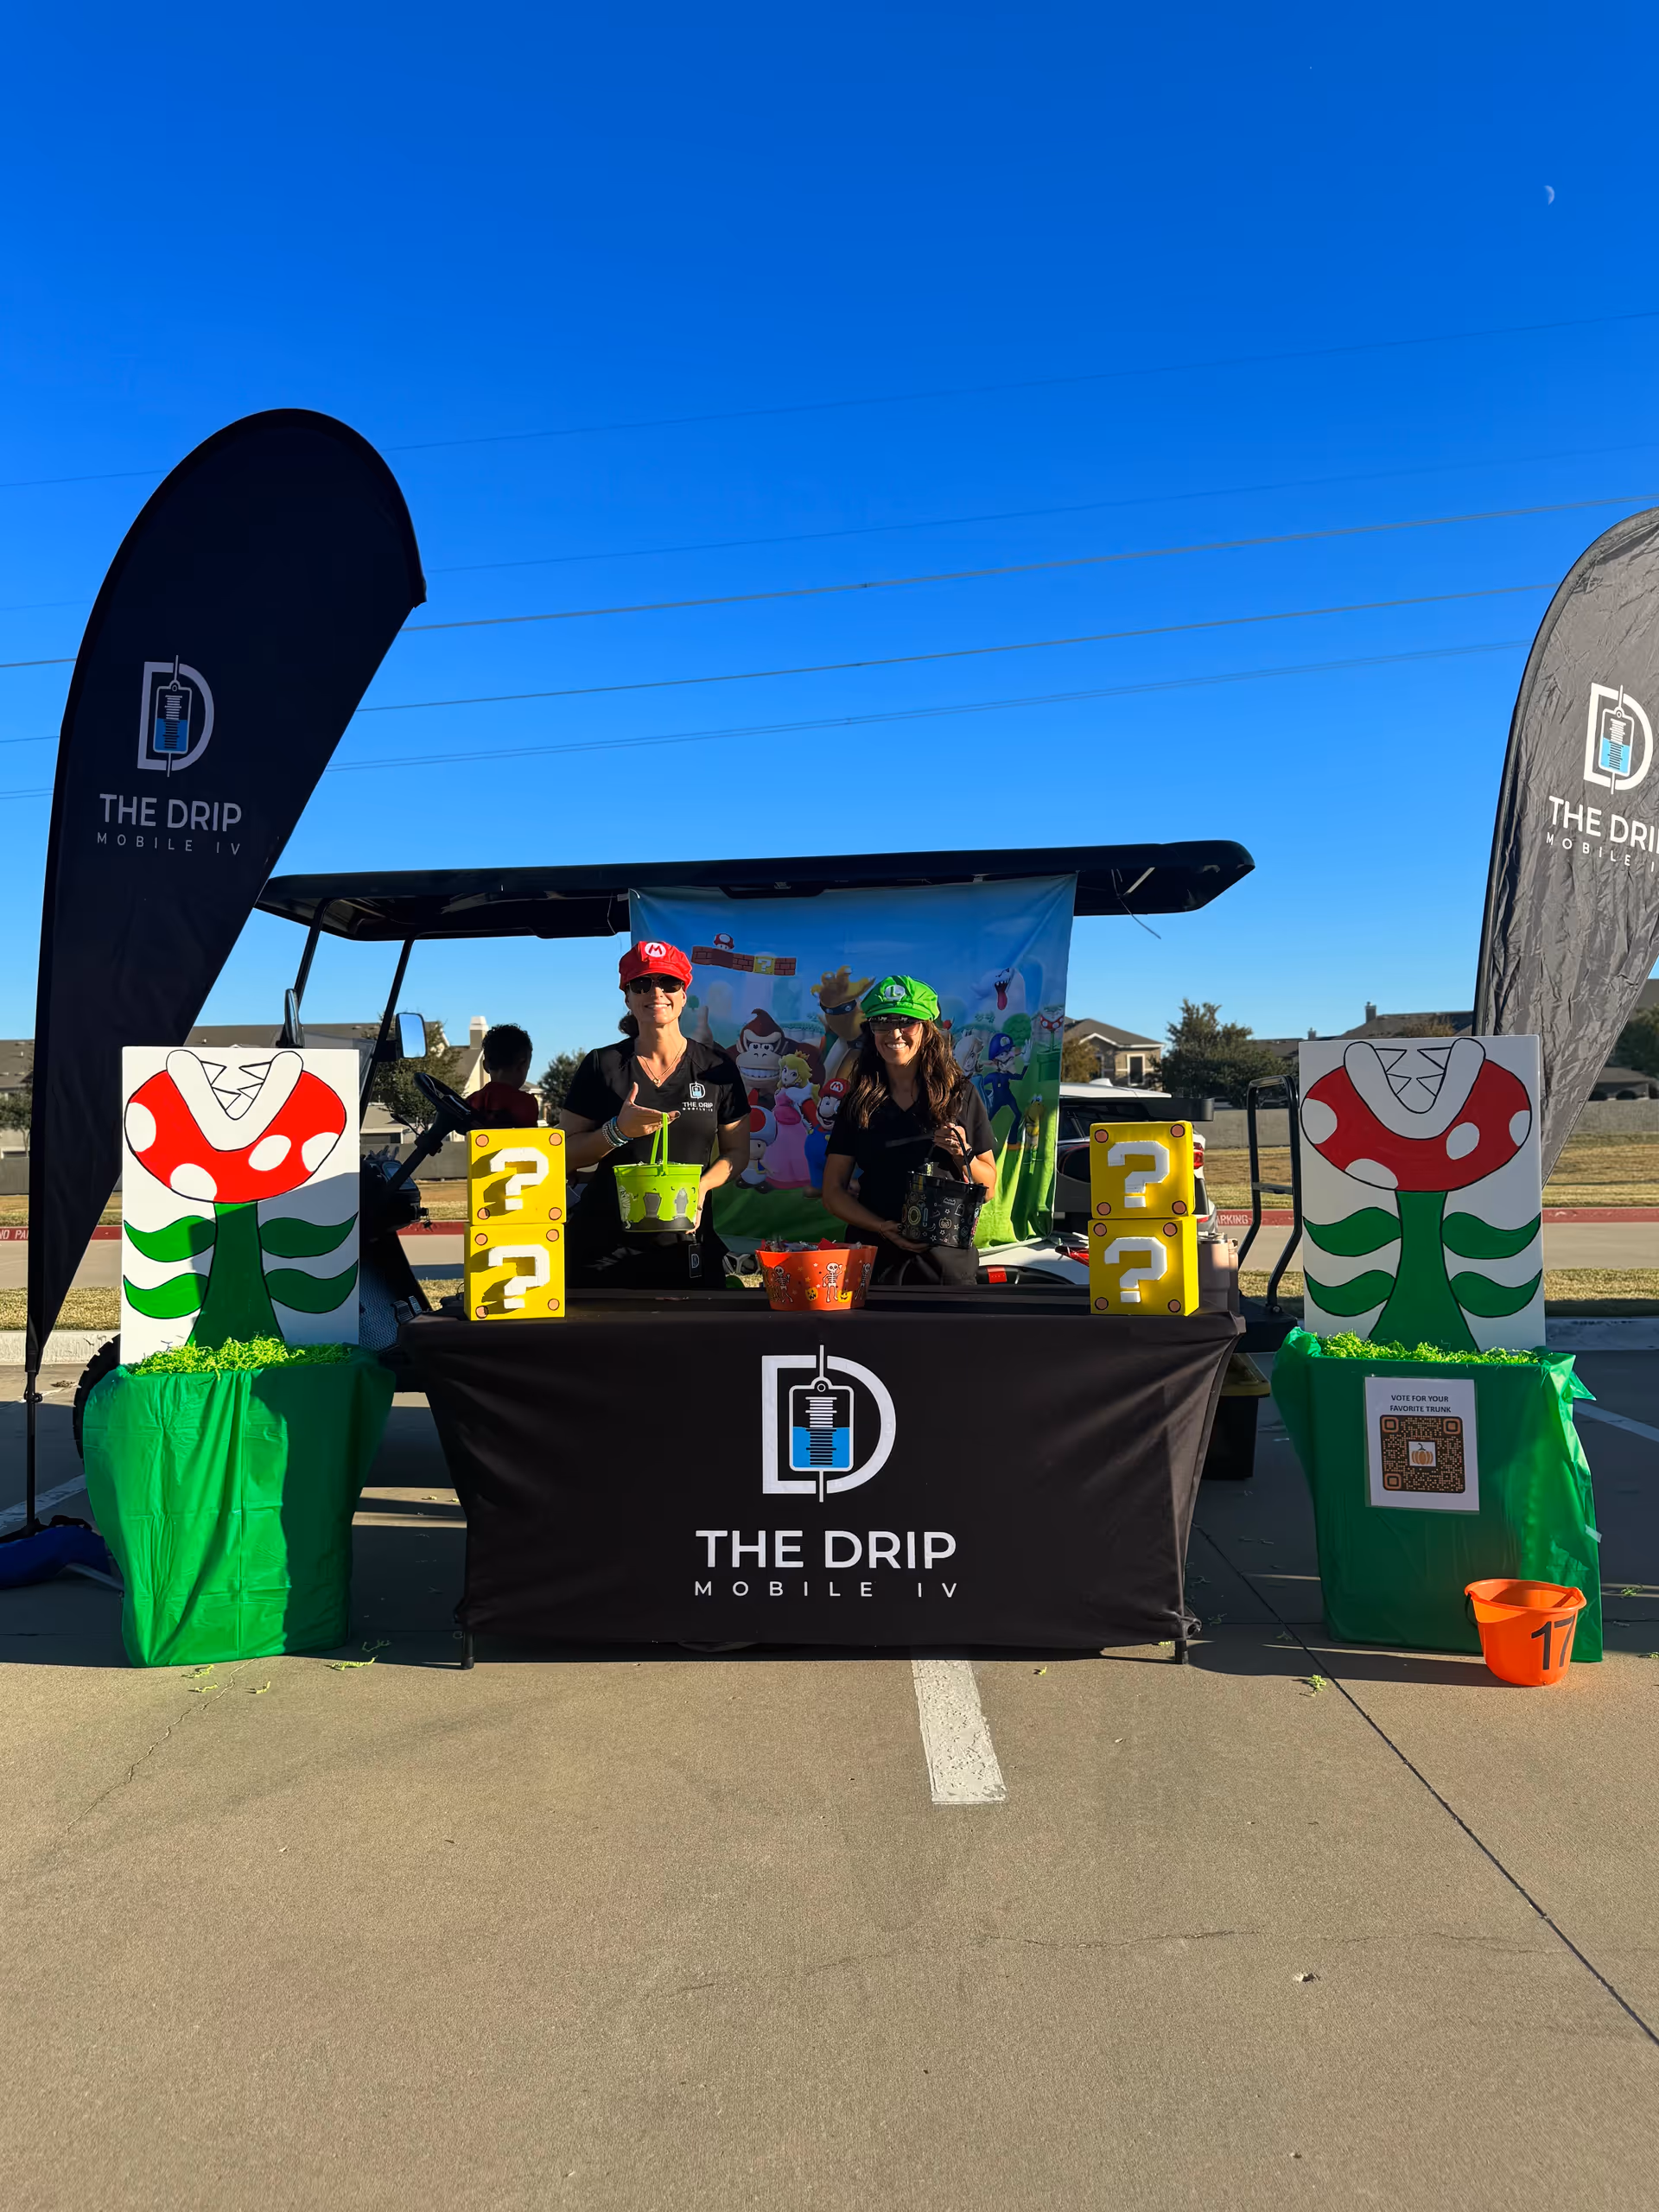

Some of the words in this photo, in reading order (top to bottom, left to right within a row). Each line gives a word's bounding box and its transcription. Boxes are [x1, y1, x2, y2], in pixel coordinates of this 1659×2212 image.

[99, 793, 157, 827] THE
[167, 798, 242, 832] DRIP
[1548, 795, 1602, 837] THE
[1610, 814, 1659, 855] DRI
[97, 832, 193, 852] MOBILE
[216, 842, 240, 855] IV
[1546, 831, 1631, 867] MOBILE
[649, 944, 663, 955] M
[696, 1530, 804, 1568] THE
[824, 1530, 957, 1569] DRIP
[695, 1580, 873, 1598] MOBILE
[918, 1582, 957, 1598] IV
[1530, 1614, 1575, 1671] 17
